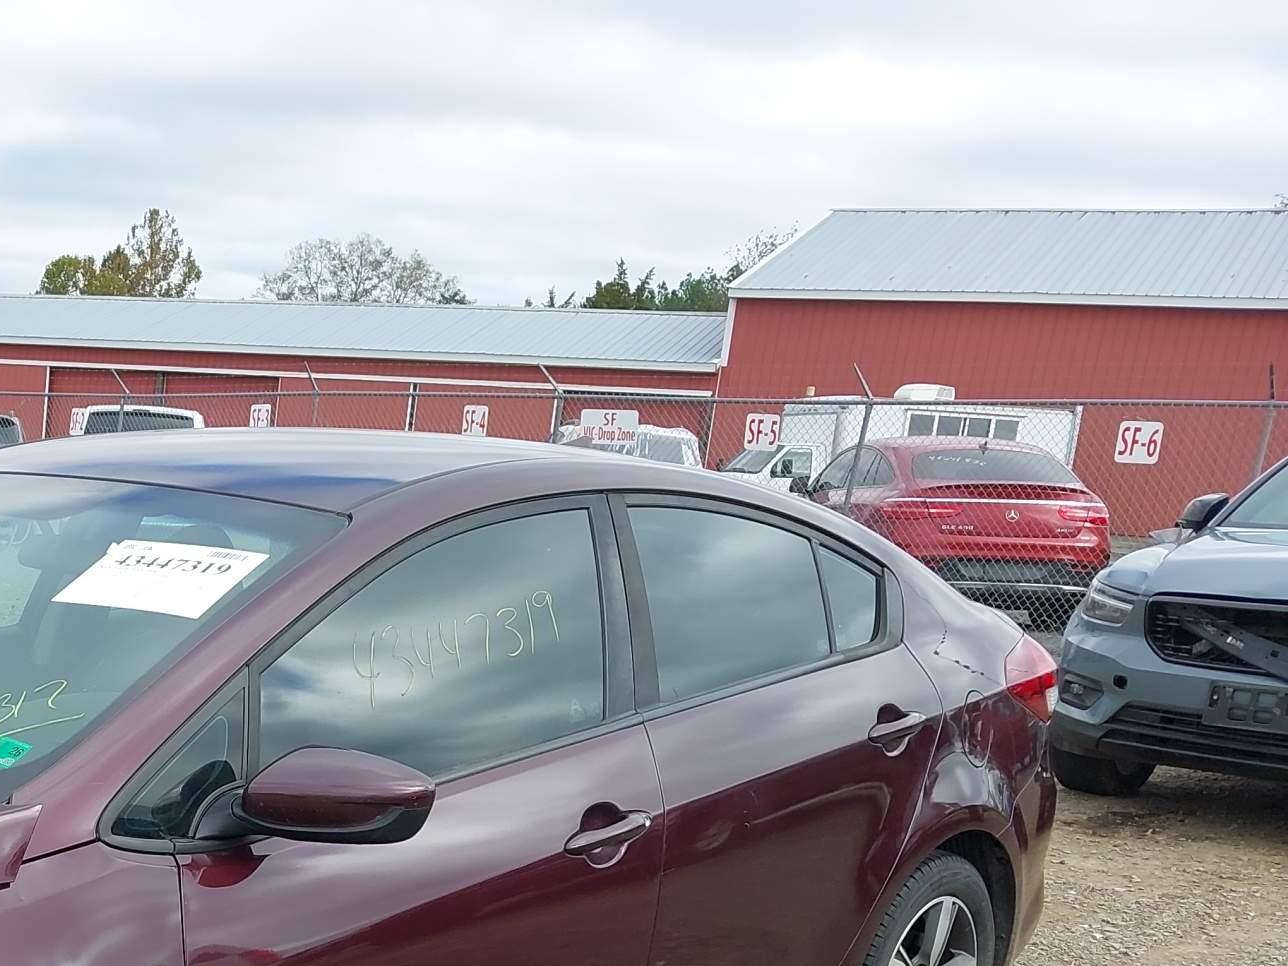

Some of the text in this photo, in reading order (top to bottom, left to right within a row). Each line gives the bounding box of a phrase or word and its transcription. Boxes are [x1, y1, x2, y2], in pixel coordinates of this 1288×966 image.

[71, 411, 85, 431] SF-2
[463, 409, 486, 433] SF-4
[603, 412, 617, 426] SF
[617, 427, 636, 441] Zone
[747, 418, 778, 446] SF-5
[1117, 426, 1159, 458] SF-6
[114, 554, 233, 575] 43447319
[352, 590, 561, 712] 43447319
